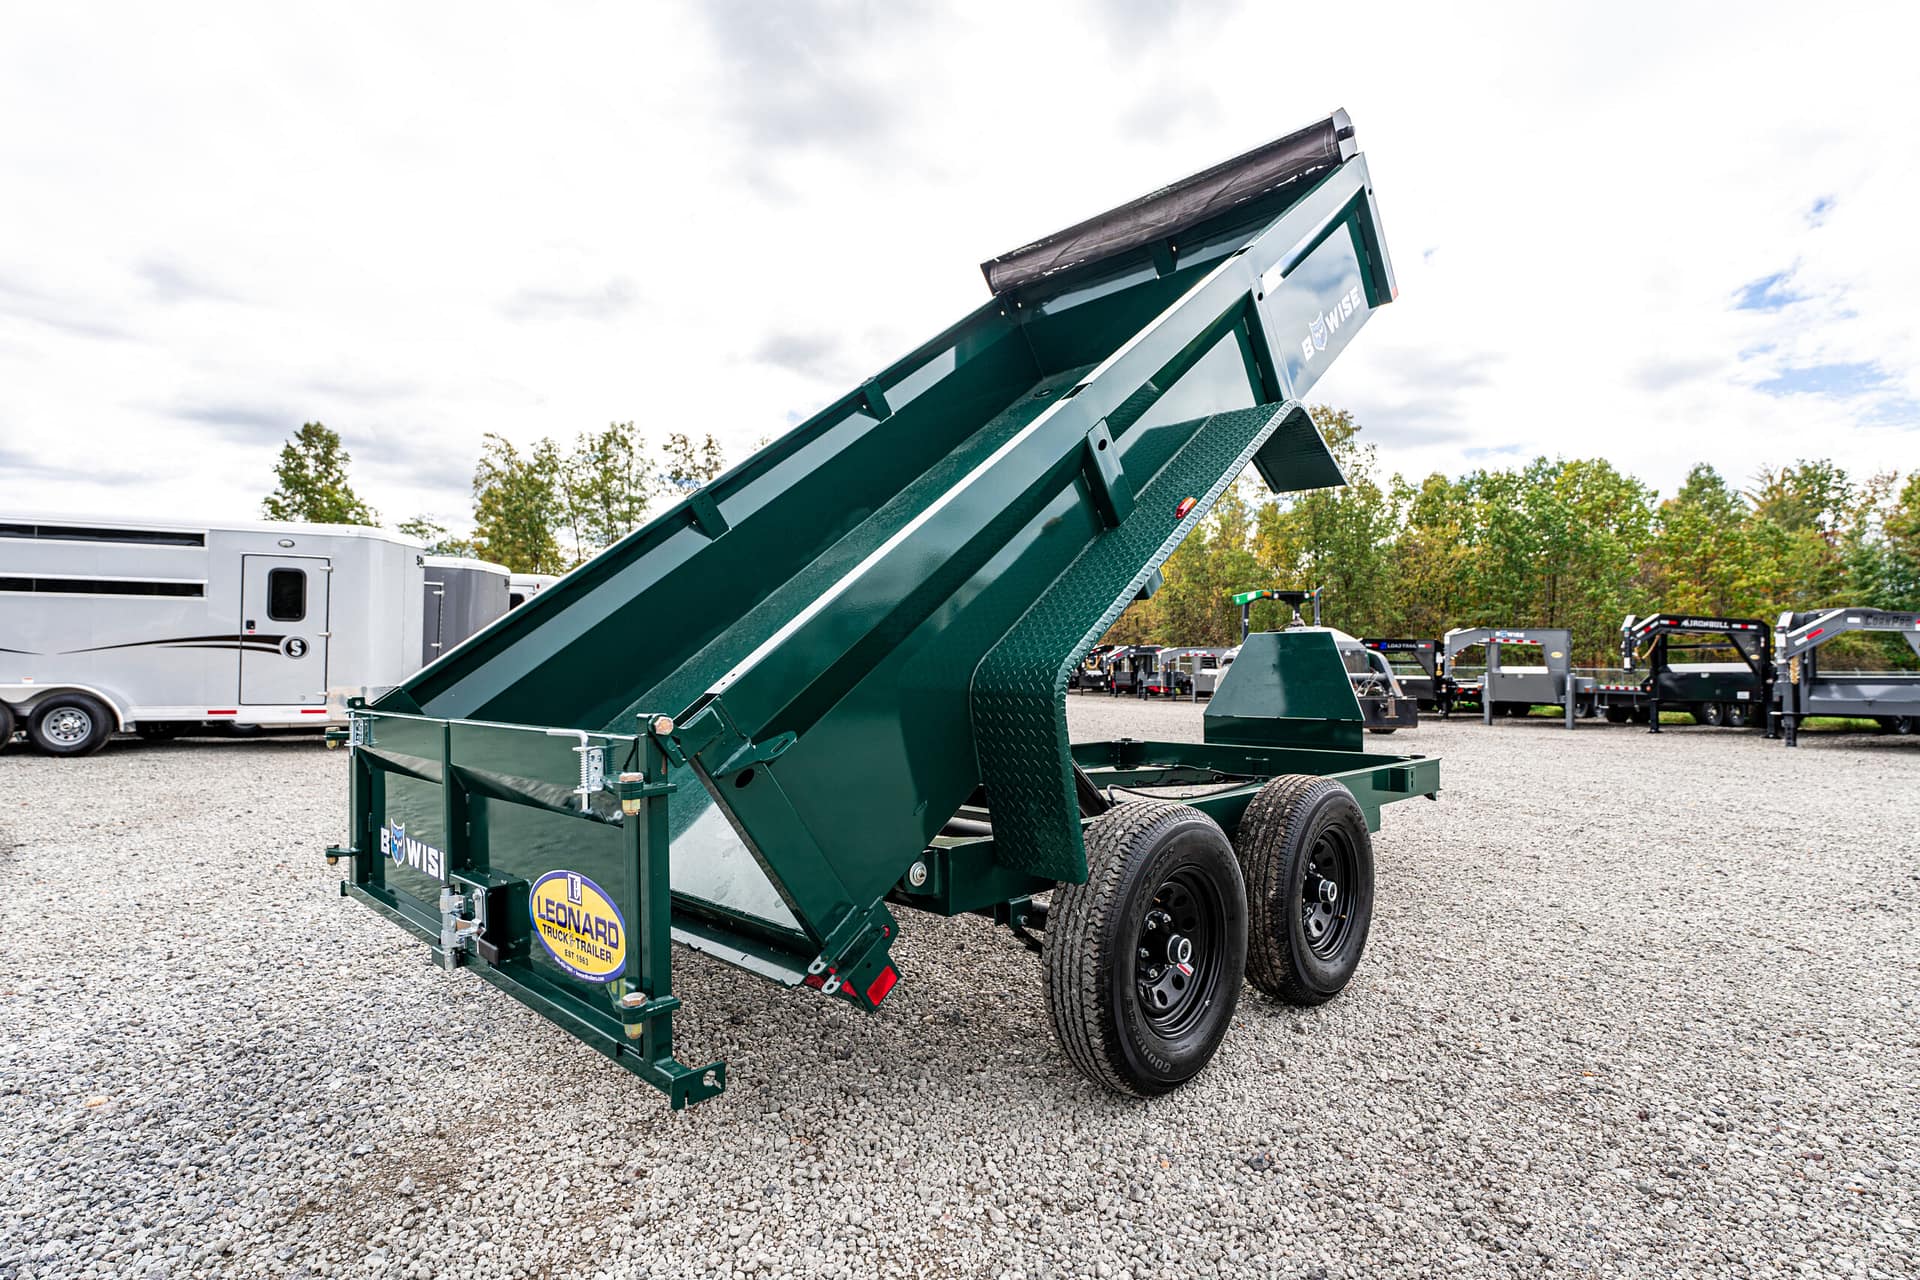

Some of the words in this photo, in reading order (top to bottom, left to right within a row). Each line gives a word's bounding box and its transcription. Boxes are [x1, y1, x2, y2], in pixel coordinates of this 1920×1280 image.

[290, 640, 302, 656] S
[537, 895, 619, 950] LEONARD
[542, 923, 568, 945] TRUCK
[575, 937, 612, 964] TRAILER
[564, 949, 575, 960] EST
